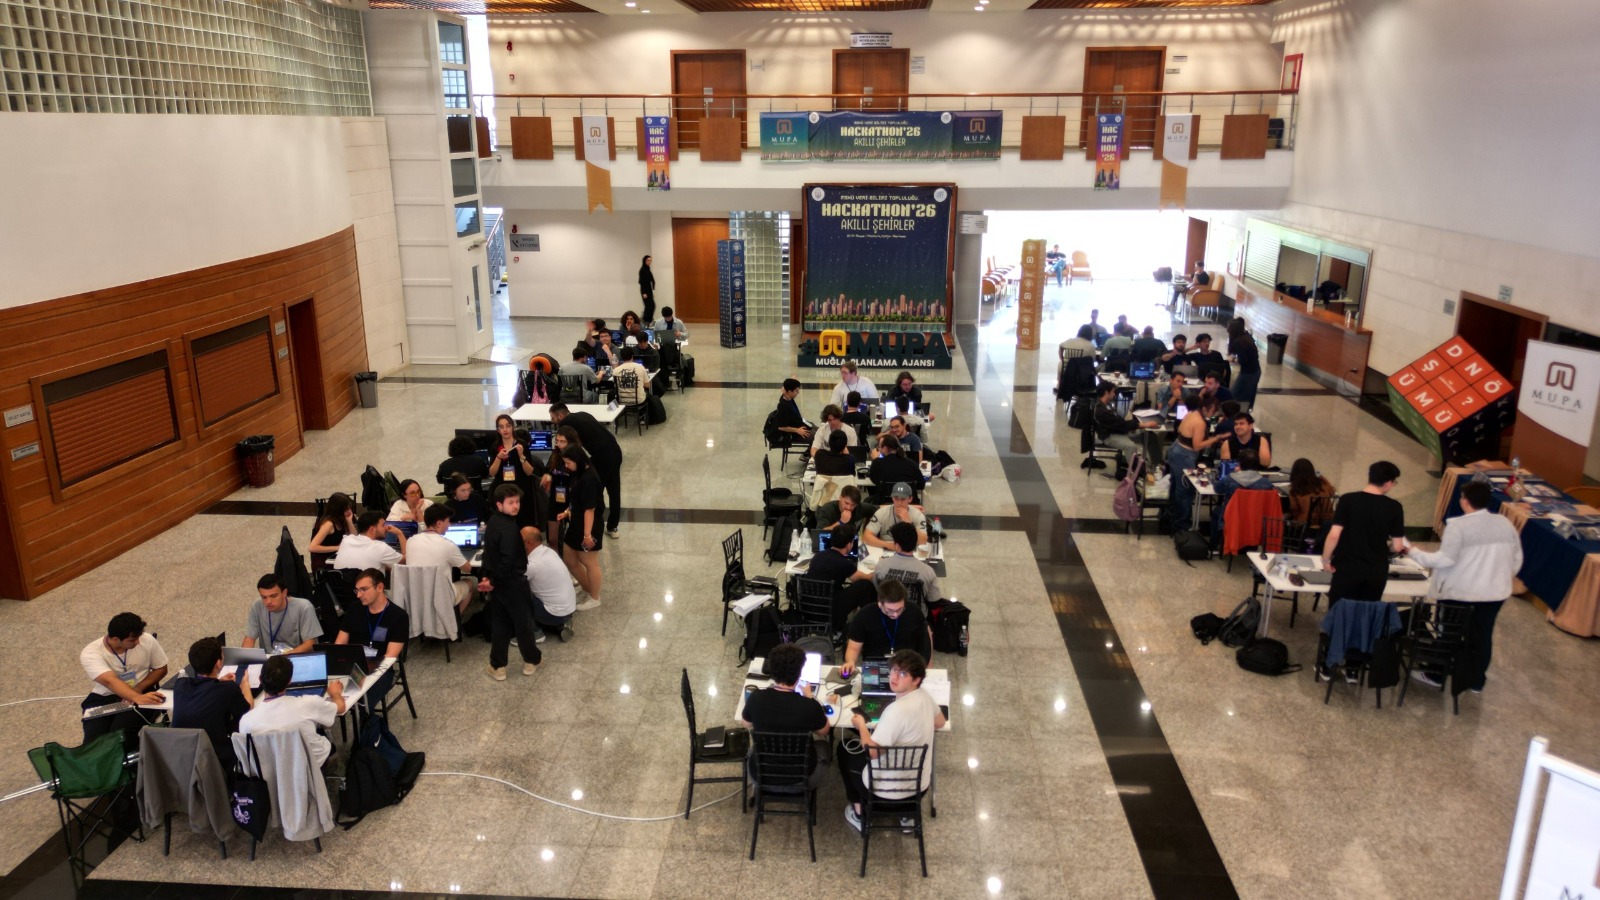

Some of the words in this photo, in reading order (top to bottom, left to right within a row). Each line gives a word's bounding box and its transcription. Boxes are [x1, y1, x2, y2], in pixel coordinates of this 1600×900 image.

[840, 126, 920, 136] HACKATHON'26
[854, 138, 875, 146] AKILLI
[876, 137, 906, 148] ŞEHİRLER
[822, 203, 936, 217] HACKATHON'26
[841, 219, 870, 230] AKILLI
[873, 217, 914, 234] ŞEHİRLER
[816, 357, 846, 366] MUĞLA
[1422, 359, 1439, 372] Ş
[1446, 345, 1463, 358] D
[1464, 362, 1482, 377] N
[1484, 380, 1503, 393] Ö
[1398, 374, 1416, 386] Ü
[1415, 392, 1434, 407] M
[1435, 411, 1452, 424] Ü
[1532, 390, 1582, 409] MUPA
